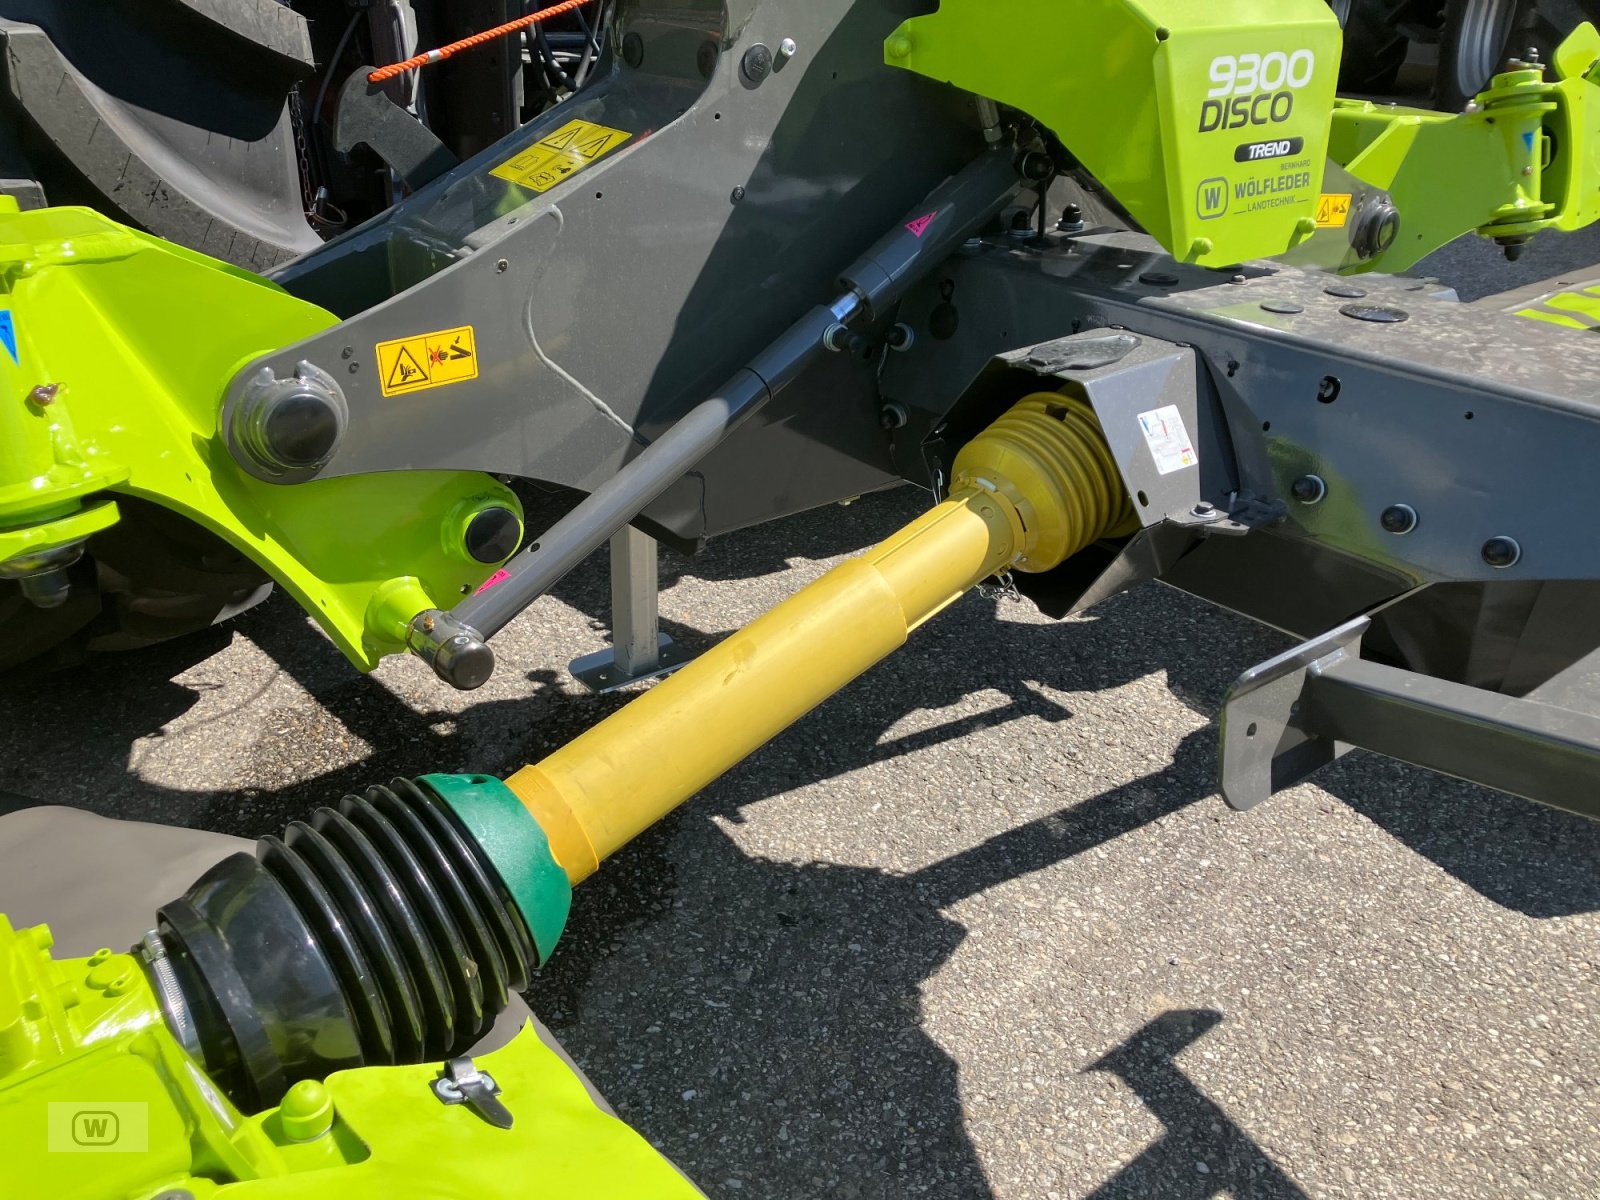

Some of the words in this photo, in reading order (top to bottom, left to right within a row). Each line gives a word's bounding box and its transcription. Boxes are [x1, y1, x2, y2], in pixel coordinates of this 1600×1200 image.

[1208, 49, 1315, 97] 9300
[1198, 91, 1294, 133] DISCO
[1249, 140, 1291, 159] TREND
[1280, 159, 1311, 171] BERNHARD
[1234, 171, 1311, 199] WÖLFLEDER
[1204, 187, 1221, 210] W
[1247, 195, 1295, 212] LANDTECHNIK
